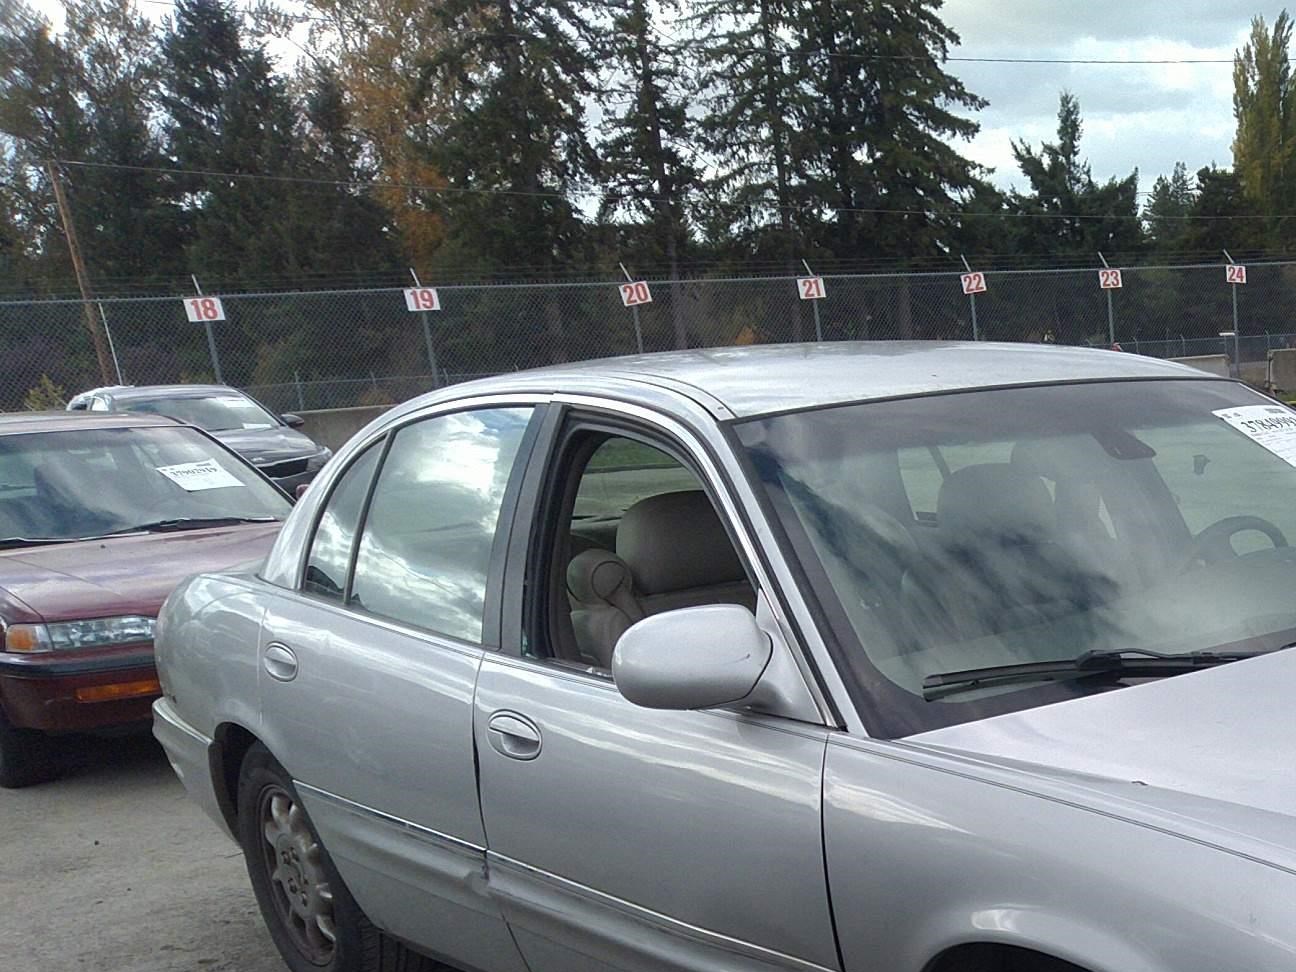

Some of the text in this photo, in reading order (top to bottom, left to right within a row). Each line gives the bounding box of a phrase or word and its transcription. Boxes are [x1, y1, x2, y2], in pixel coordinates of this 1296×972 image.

[964, 274, 985, 292] 22
[1101, 270, 1120, 287] 23
[1228, 266, 1245, 282] 24
[623, 282, 649, 304] 20
[802, 279, 821, 298] 21
[190, 299, 218, 320] 18
[410, 290, 435, 310] 19
